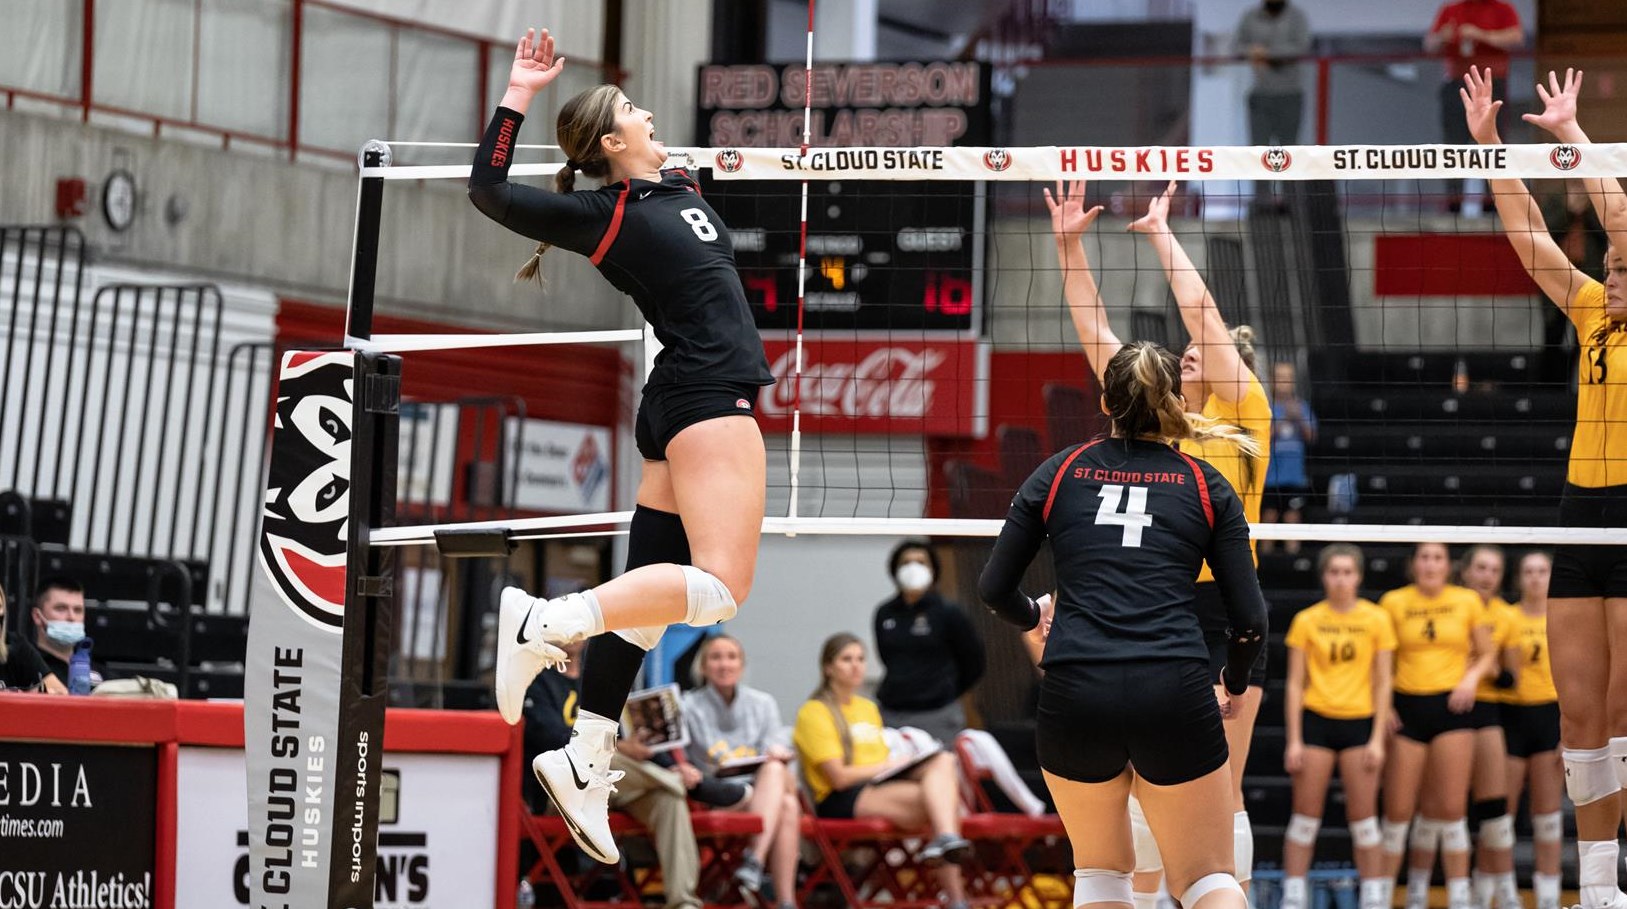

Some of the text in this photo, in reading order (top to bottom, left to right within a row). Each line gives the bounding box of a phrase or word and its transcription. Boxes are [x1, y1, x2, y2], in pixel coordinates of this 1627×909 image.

[703, 62, 980, 107] RED SEVERSON
[491, 118, 515, 168] HUSKIES
[811, 150, 877, 170] CLOUD
[883, 150, 943, 169] STATE
[1060, 149, 1214, 172] HUSKIES
[1333, 147, 1507, 169] ST. CLOUD STATE
[680, 208, 718, 242] 8
[1588, 345, 1607, 385] 13
[1073, 467, 1186, 486] ST. CLOUD STATE
[1094, 484, 1153, 548] 4
[271, 646, 304, 758] STATE
[301, 735, 326, 868] HUSKIES
[350, 730, 369, 884] sports imports
[262, 768, 298, 895] CLOUD
[50, 870, 151, 909] Athletics!
